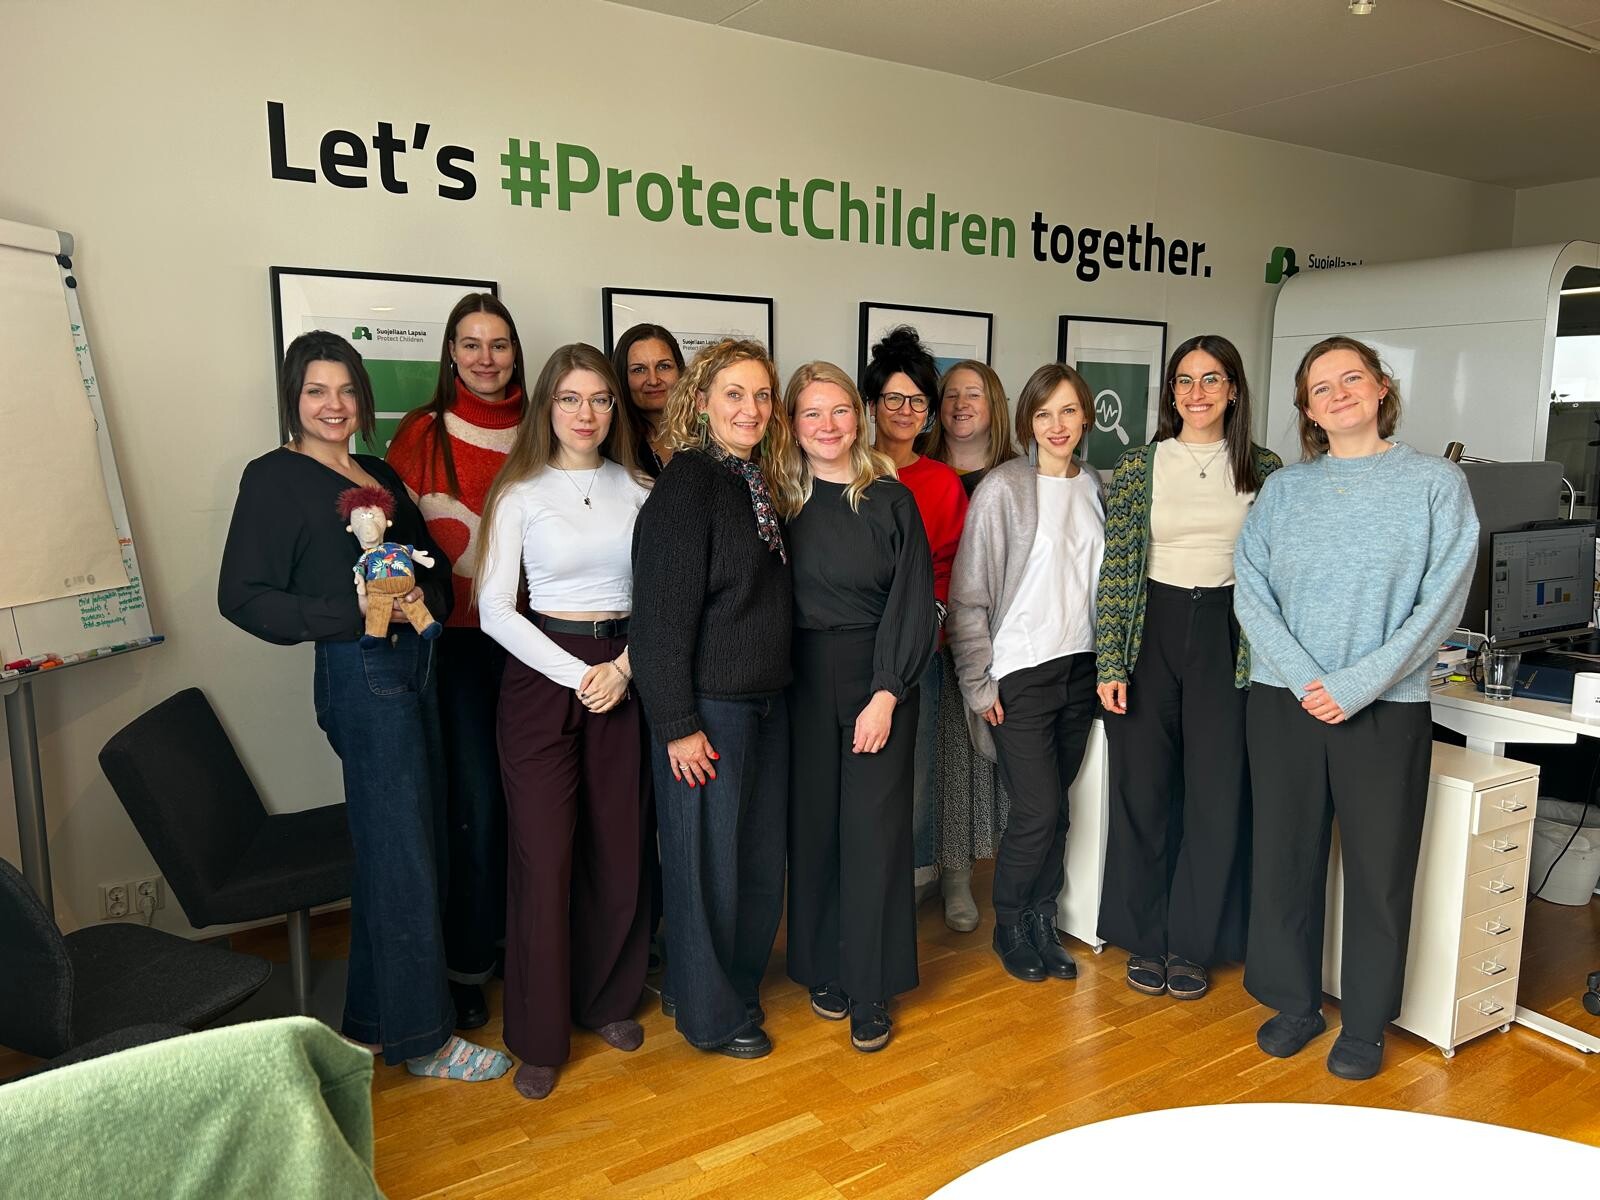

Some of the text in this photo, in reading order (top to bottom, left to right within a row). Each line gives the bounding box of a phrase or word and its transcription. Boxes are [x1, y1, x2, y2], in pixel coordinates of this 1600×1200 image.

[267, 101, 1212, 282] Let’s #ProtectChildren together.
[377, 328, 427, 337] Suojellaan Lapsia
